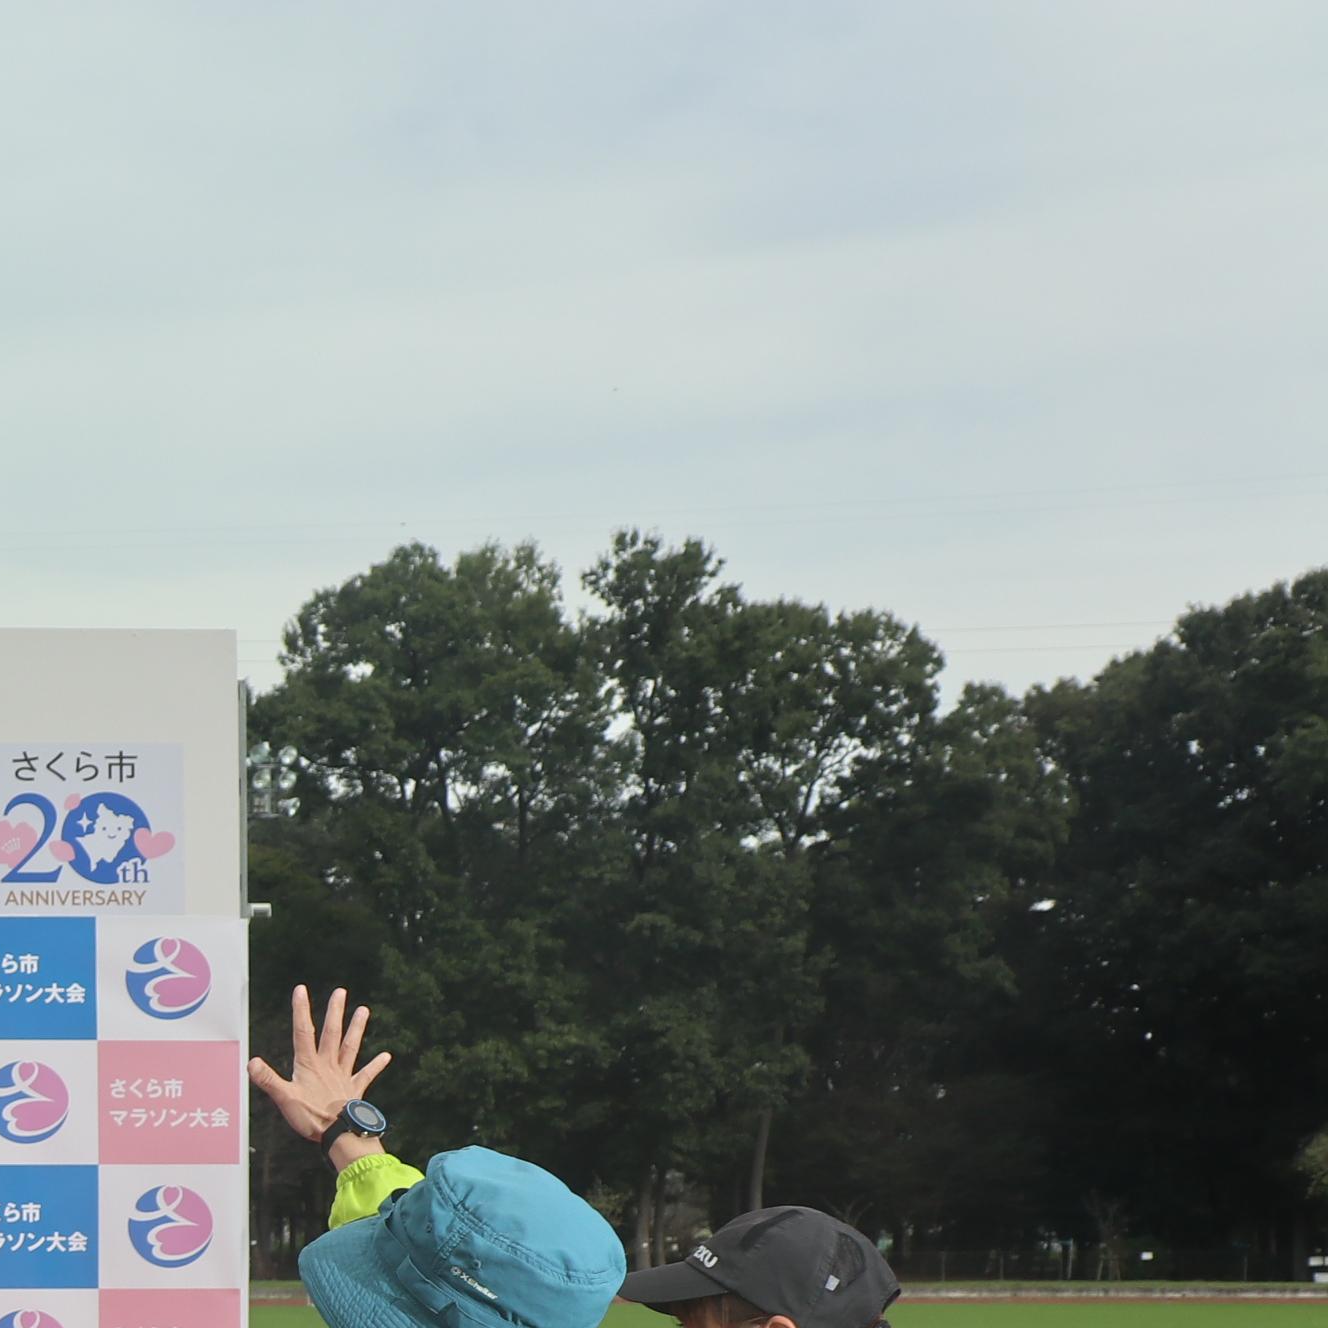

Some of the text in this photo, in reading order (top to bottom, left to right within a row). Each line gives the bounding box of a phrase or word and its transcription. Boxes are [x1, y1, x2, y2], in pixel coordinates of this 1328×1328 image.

[12, 750, 138, 783] さくら市
[4, 890, 147, 906] ANNIVERSARY
[110, 1078, 184, 1098] さくら市
[110, 1107, 230, 1127] マラソン大会
